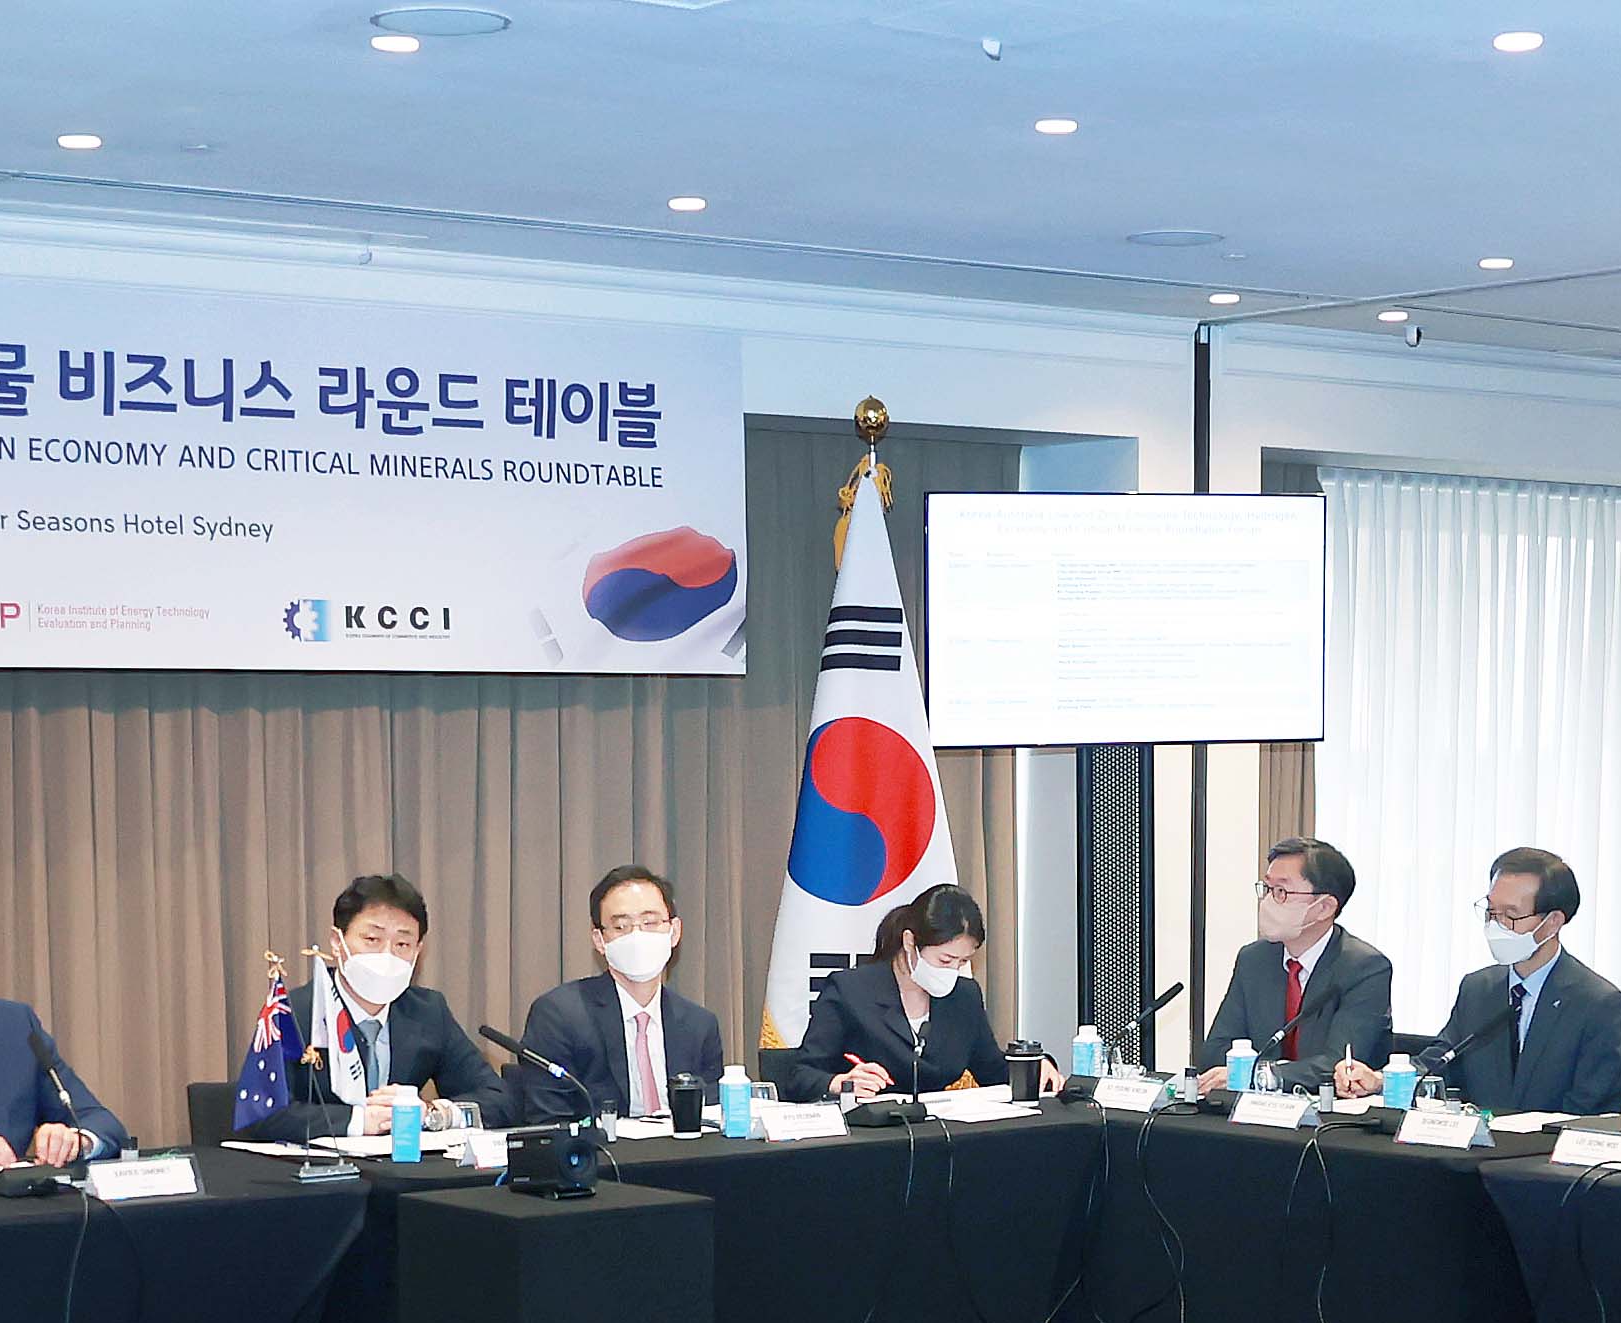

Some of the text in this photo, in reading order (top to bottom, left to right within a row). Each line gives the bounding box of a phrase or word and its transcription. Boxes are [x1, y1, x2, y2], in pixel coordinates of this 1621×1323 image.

[58, 349, 296, 423] 비즈니스
[318, 366, 485, 436] 라운드
[505, 377, 662, 449] 테이블
[28, 437, 168, 467] ECONOMY
[178, 444, 236, 470] AND
[246, 447, 360, 476] CRITICAL
[370, 453, 494, 481] MINERALS
[503, 459, 664, 488] ROUNDTABLE
[17, 510, 115, 534] Seasons
[124, 514, 184, 536] Hotel
[193, 516, 274, 543] Sydney
[37, 603, 211, 620] Korea Institute of Energy Technology
[38, 617, 152, 632] Evaluation and Planning
[344, 605, 451, 630] KCCI
